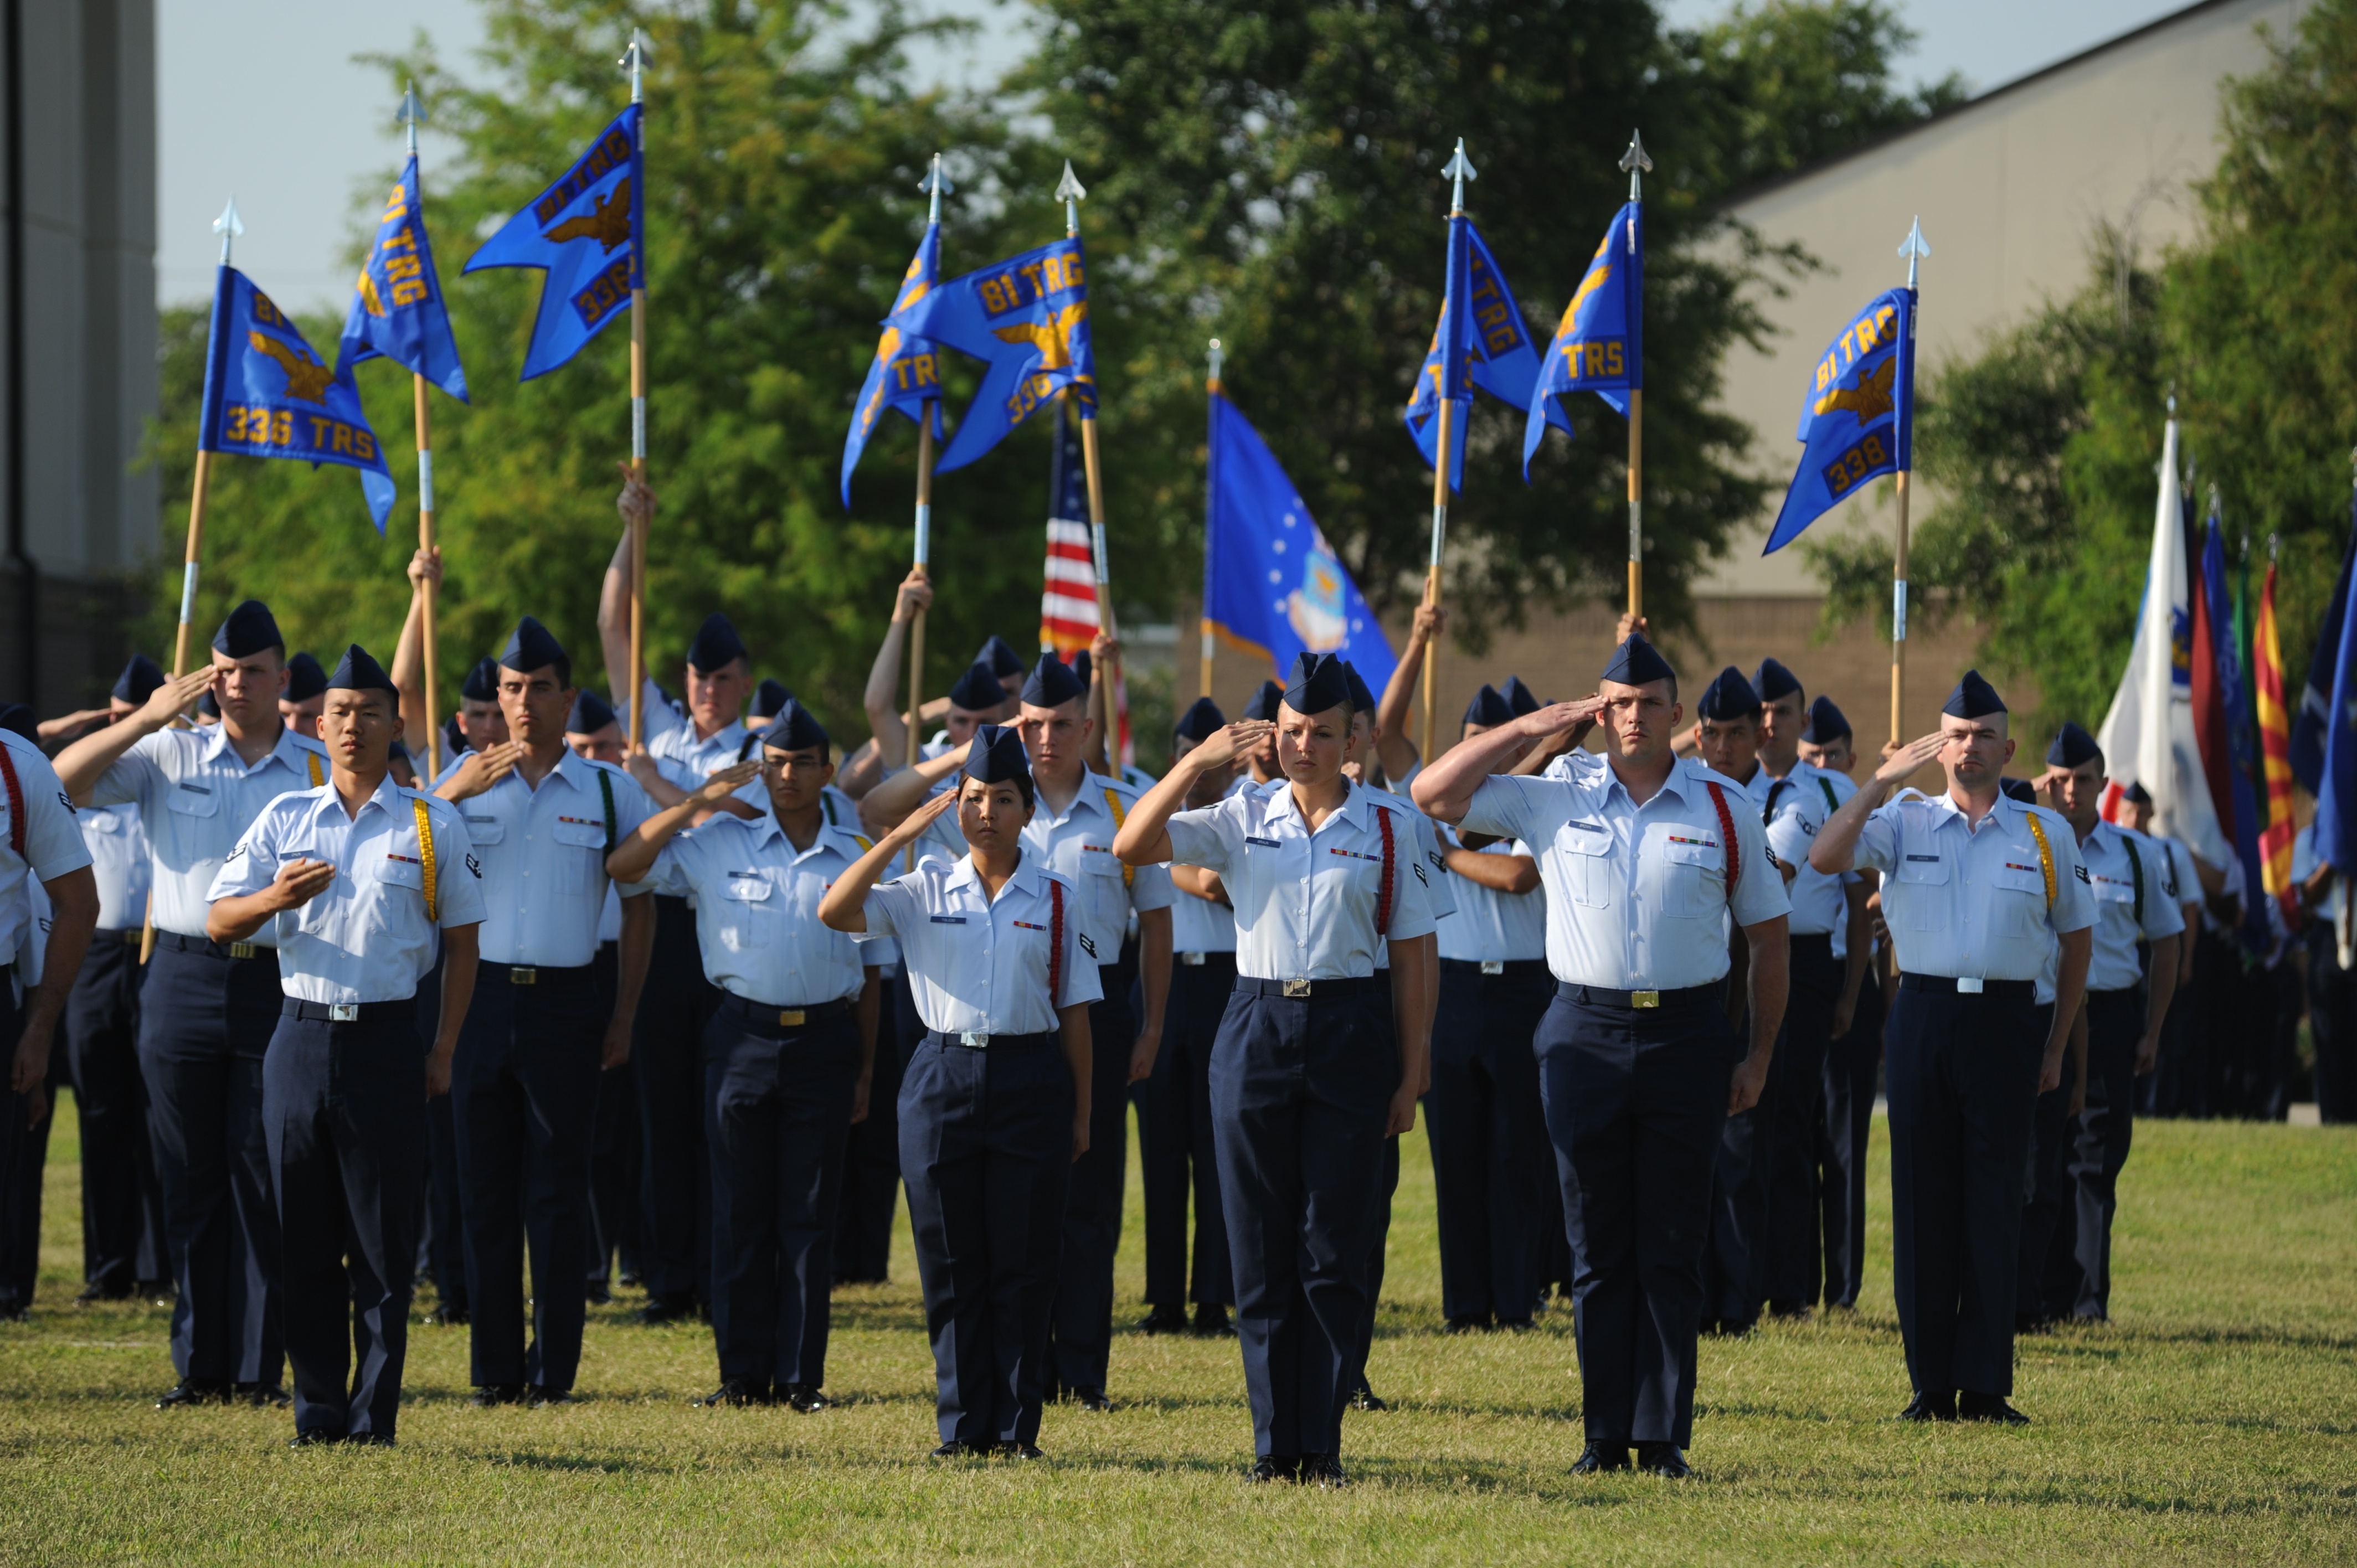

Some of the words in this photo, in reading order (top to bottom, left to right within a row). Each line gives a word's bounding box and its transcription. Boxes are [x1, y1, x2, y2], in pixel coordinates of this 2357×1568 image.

[538, 190, 569, 222] 81
[571, 129, 630, 189] TRG
[382, 226, 428, 307] TRG
[578, 262, 630, 323] 336
[980, 274, 1021, 314] 81
[1020, 252, 1084, 297] TRG
[1471, 277, 1517, 354] TRG
[891, 353, 941, 390] TR
[1561, 341, 1624, 380] TRS
[1816, 352, 1838, 392] 81
[1839, 305, 1898, 363] TRG
[1008, 372, 1053, 425] 336
[226, 406, 294, 445] 336
[308, 416, 375, 460] TRS
[1829, 435, 1887, 493] 338
